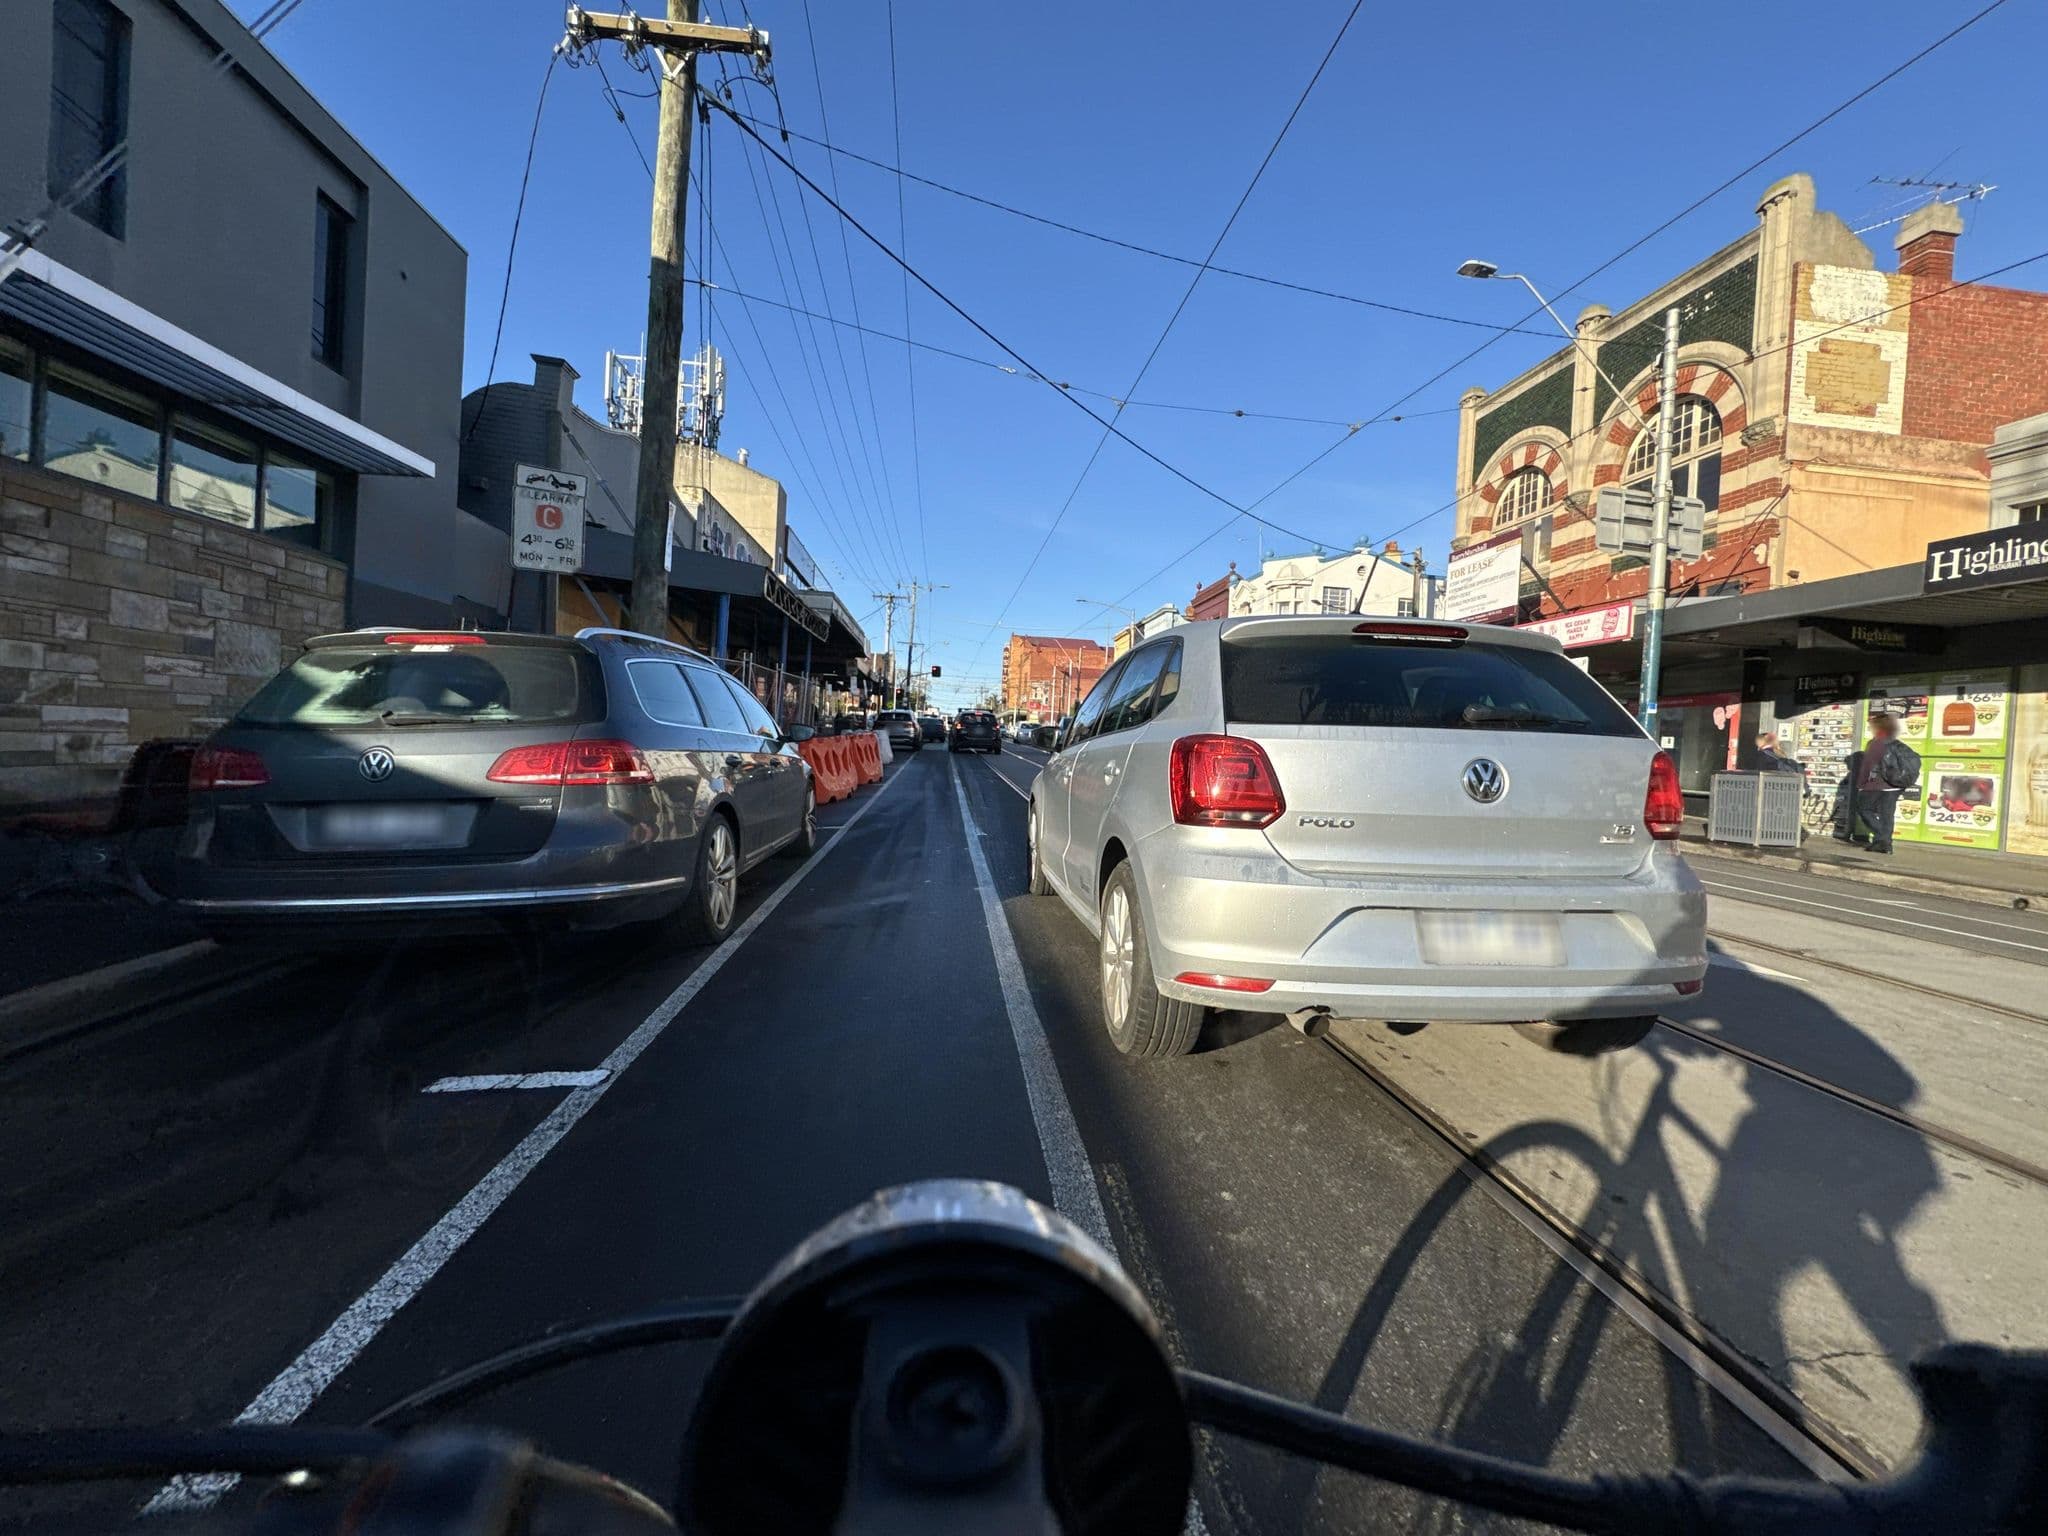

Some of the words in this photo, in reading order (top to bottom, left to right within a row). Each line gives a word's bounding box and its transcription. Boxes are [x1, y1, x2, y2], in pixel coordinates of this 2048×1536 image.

[543, 507, 556, 527] C
[520, 552, 542, 561] MON
[560, 557, 576, 566] FRI
[1450, 567, 1466, 580] FOR
[1468, 558, 1494, 574] LEASE
[1299, 816, 1355, 829] POLO
